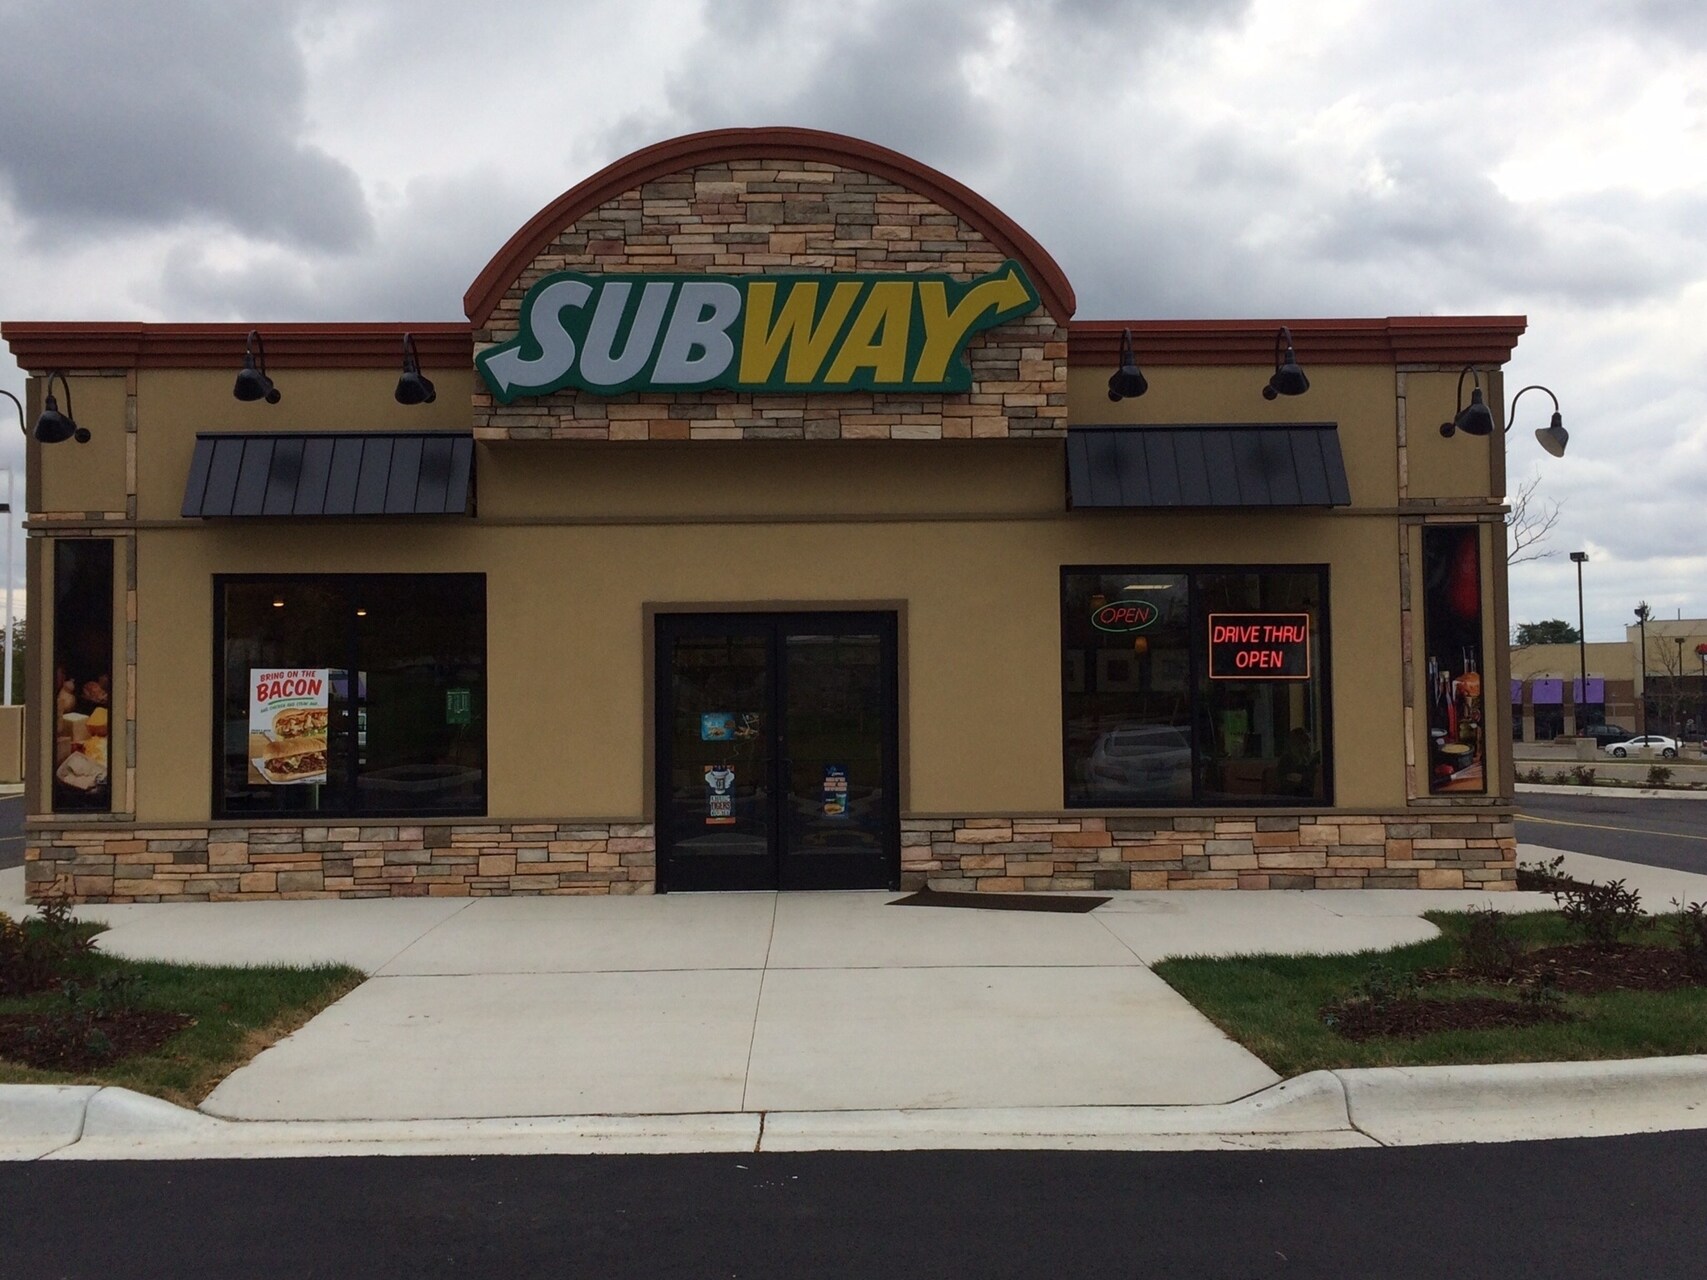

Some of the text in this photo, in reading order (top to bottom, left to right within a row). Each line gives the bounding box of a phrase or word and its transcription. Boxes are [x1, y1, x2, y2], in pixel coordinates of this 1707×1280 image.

[484, 268, 1031, 393] SUBWAY
[1100, 607, 1150, 624] OPEN
[1212, 625, 1305, 643] DRIVE THRU
[1235, 650, 1284, 668] OPEN
[260, 672, 284, 682] BRING
[256, 679, 322, 702] BACON
[710, 801, 731, 810] TIGERS
